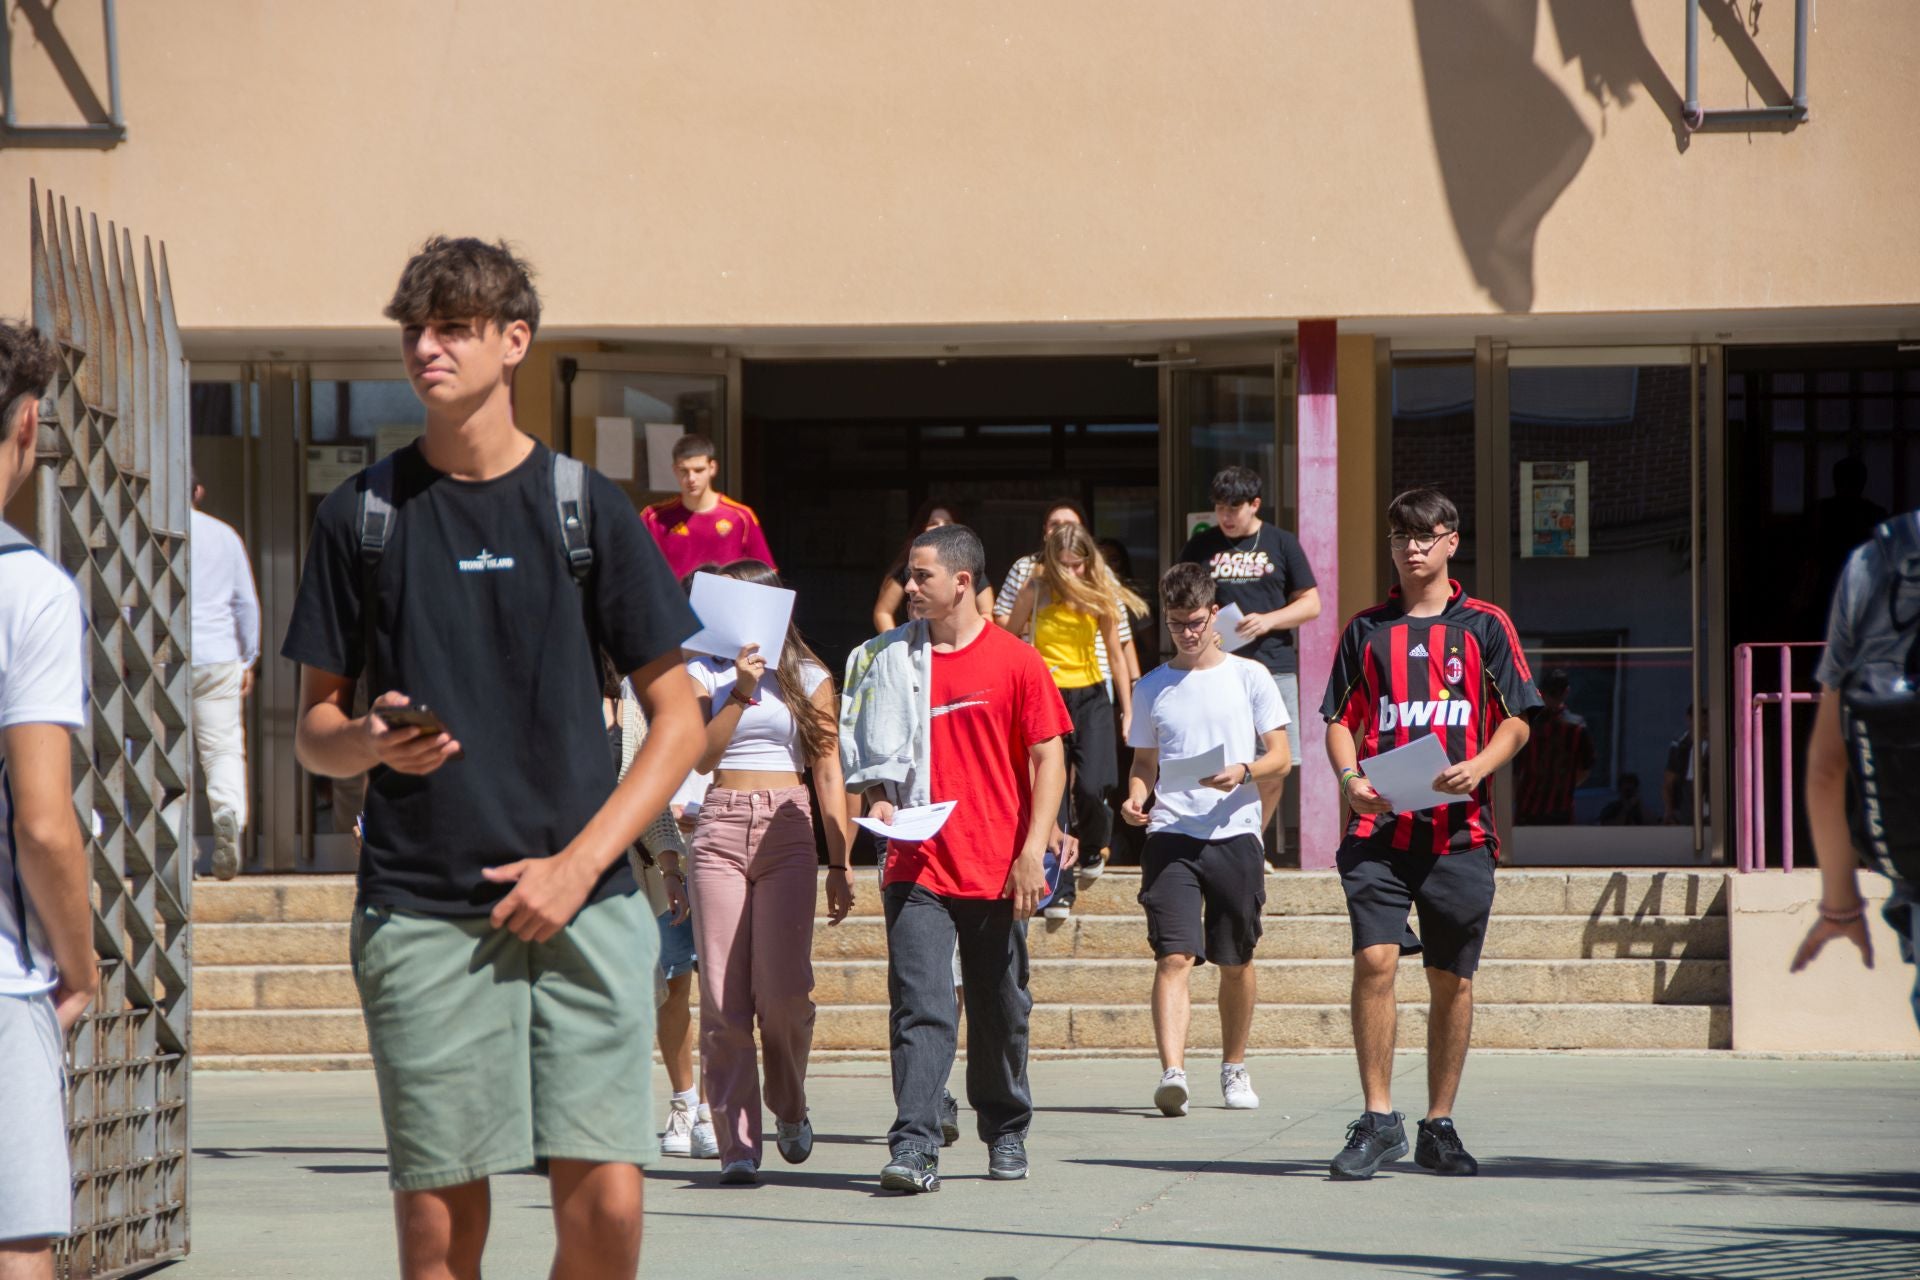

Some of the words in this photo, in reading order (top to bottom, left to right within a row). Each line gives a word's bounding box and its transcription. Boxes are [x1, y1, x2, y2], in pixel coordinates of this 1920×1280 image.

[1210, 563, 1265, 578] JONES
[1378, 690, 1472, 732] bwin
[1858, 736, 1875, 777] FILA
[1866, 797, 1884, 836] FILA
